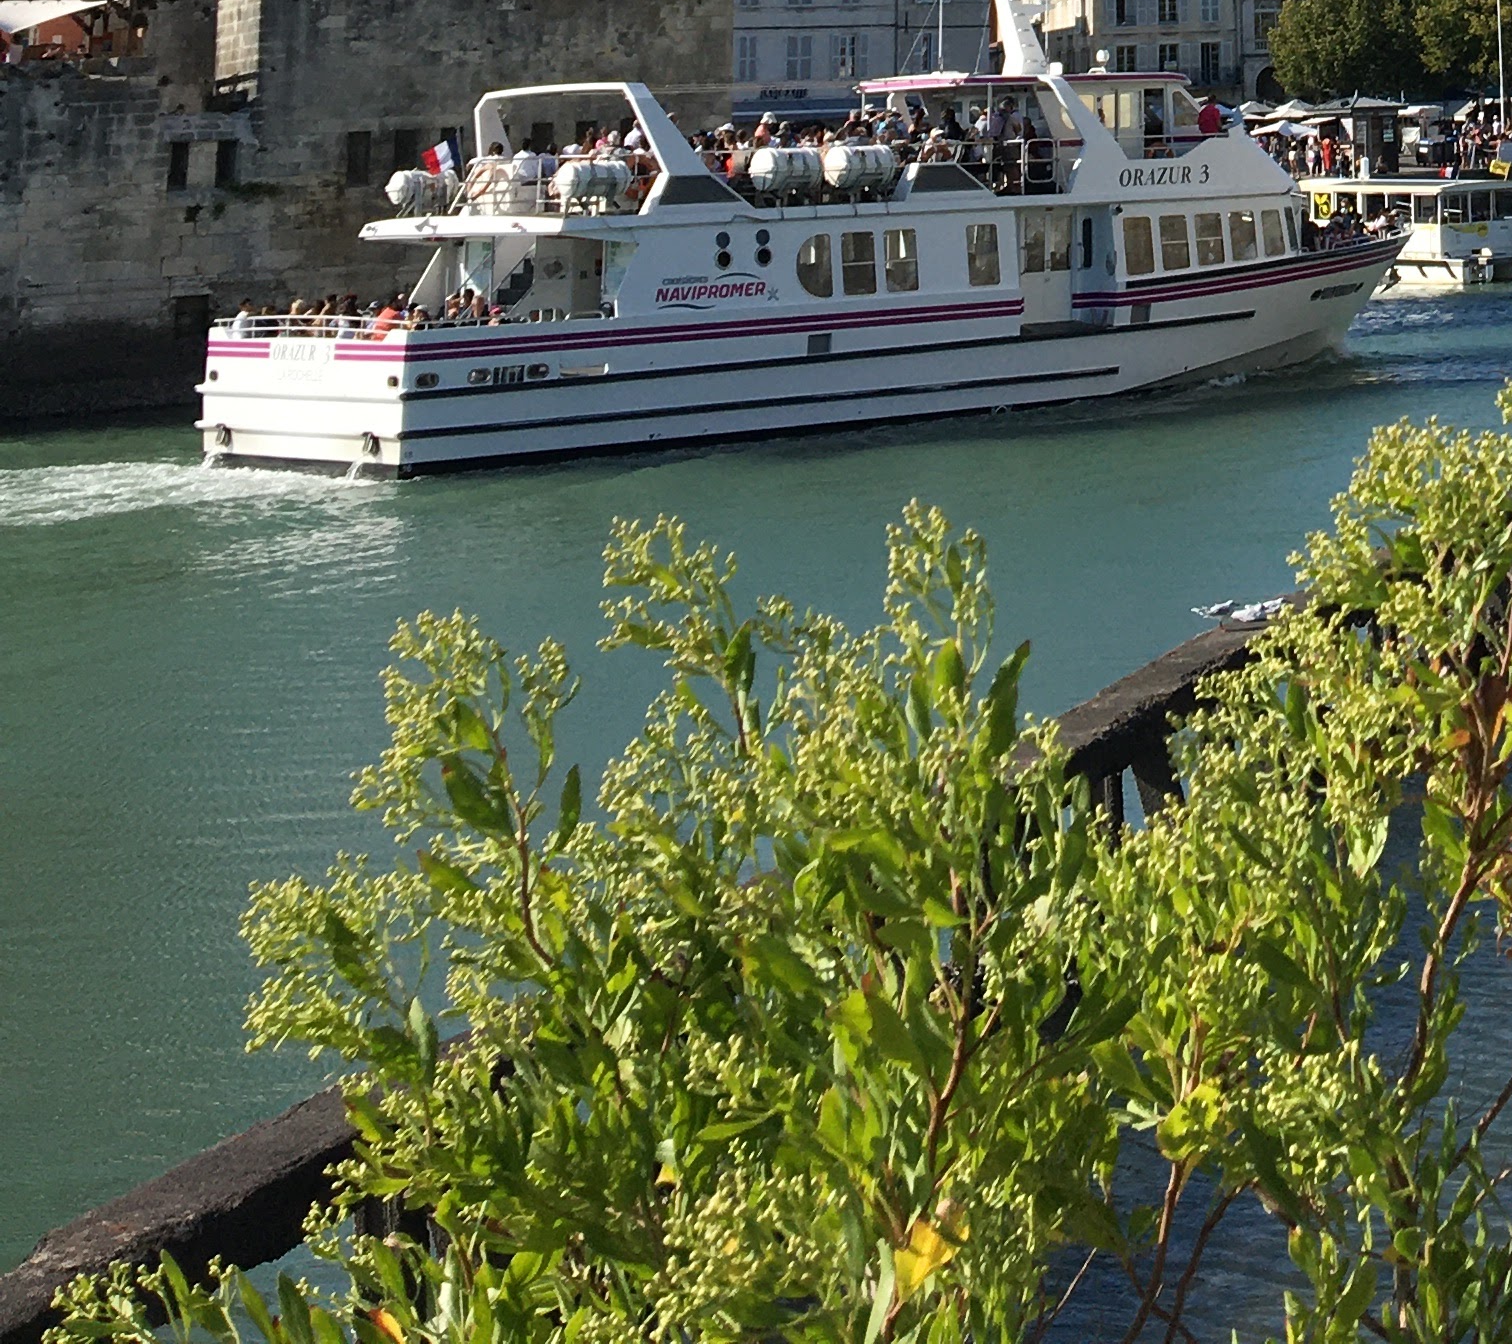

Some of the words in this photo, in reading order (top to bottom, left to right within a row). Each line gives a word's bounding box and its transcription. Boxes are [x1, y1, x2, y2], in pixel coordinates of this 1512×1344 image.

[1119, 165, 1191, 187] ORAZUR
[1199, 164, 1210, 184] 3
[655, 281, 767, 302] NAVIPROMER
[272, 343, 317, 361] ORAZUR
